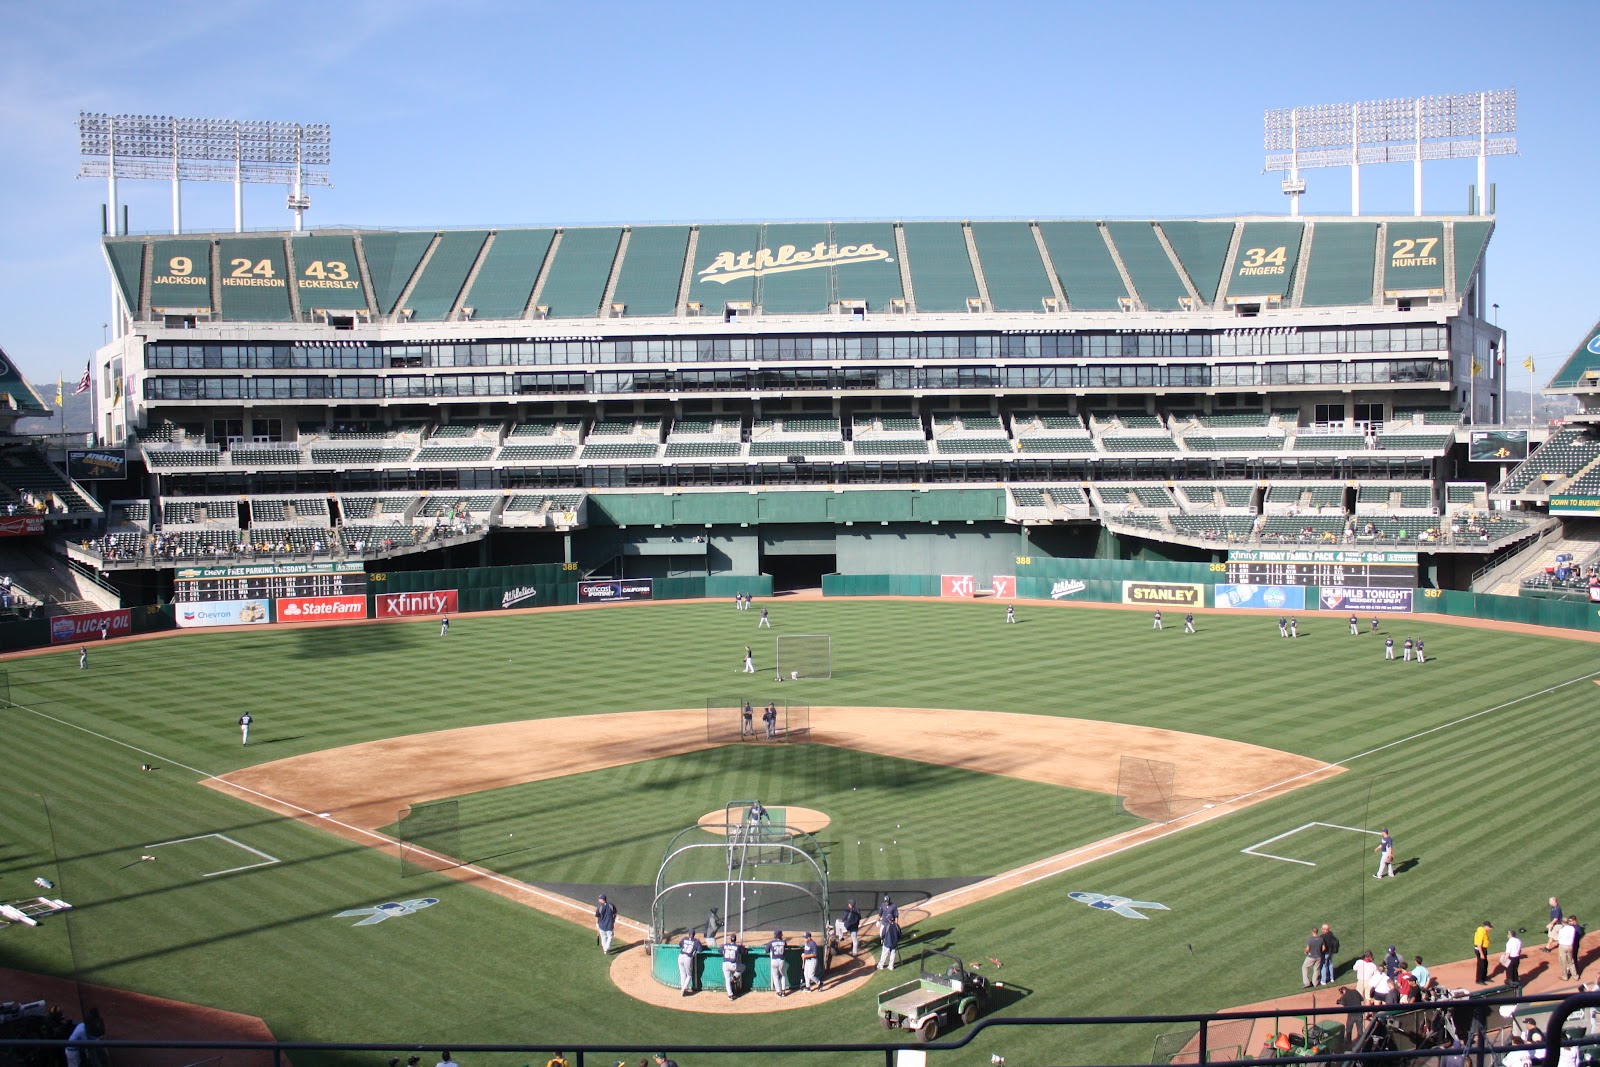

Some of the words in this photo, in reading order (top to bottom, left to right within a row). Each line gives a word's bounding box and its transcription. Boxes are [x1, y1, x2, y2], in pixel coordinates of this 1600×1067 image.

[1392, 238, 1439, 258] 27
[1243, 246, 1287, 267] 34
[169, 256, 192, 276] 9
[698, 242, 888, 284] Athletics
[1391, 257, 1437, 267] HUNTER
[231, 258, 275, 278] 24
[305, 260, 349, 280] 43
[1239, 266, 1285, 276] FINGERS
[154, 275, 206, 285] JACKSON
[222, 277, 285, 287] HENDERSON
[299, 279, 359, 289] ECKERSLEY
[86, 452, 124, 464] ATHLETICS
[1570, 499, 1578, 507] TO
[1016, 557, 1031, 565] 388
[1260, 552, 1285, 560] FRIDAY
[1287, 552, 1313, 561] FAMILY
[1314, 552, 1334, 561] PACK
[1336, 552, 1344, 561] 4
[227, 568, 244, 576] FREE
[246, 566, 273, 575] PARKING
[275, 565, 306, 574] TUESDAYS
[563, 563, 578, 571] 388
[1209, 564, 1227, 572] 362
[370, 573, 387, 581] 362
[502, 586, 536, 608] Athletics
[1133, 588, 1194, 601] STANLEY
[1343, 589, 1363, 598] MLB
[1365, 590, 1408, 599] TONIGHT
[387, 593, 447, 616] xfinity
[198, 611, 231, 619] Chevron
[113, 615, 129, 629] OIL
